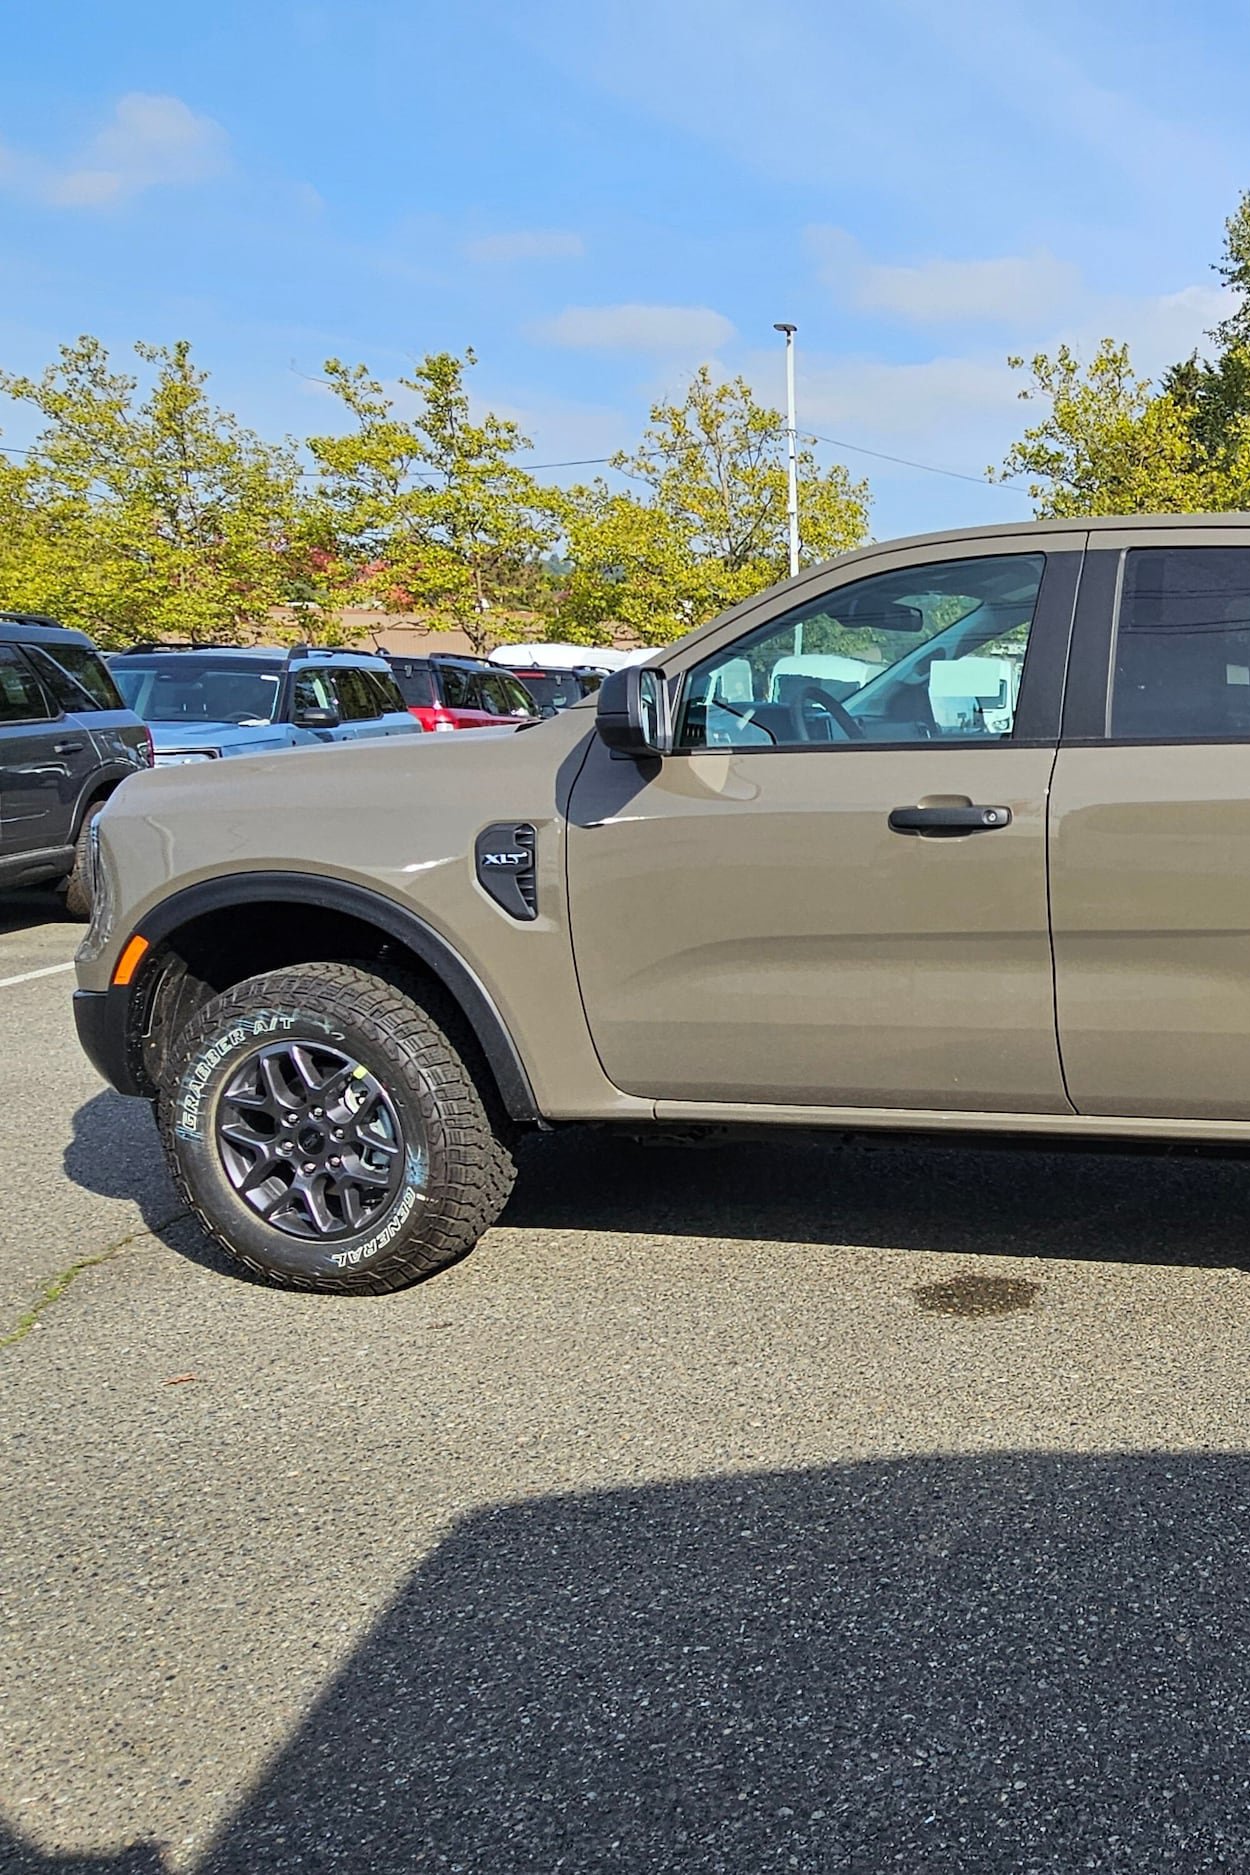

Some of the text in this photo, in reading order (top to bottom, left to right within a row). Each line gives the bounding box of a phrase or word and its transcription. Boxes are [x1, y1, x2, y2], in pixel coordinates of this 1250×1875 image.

[484, 852, 528, 864] XLT
[181, 1017, 295, 1131] GRABBER A/T
[332, 1187, 415, 1268] GENERAL
